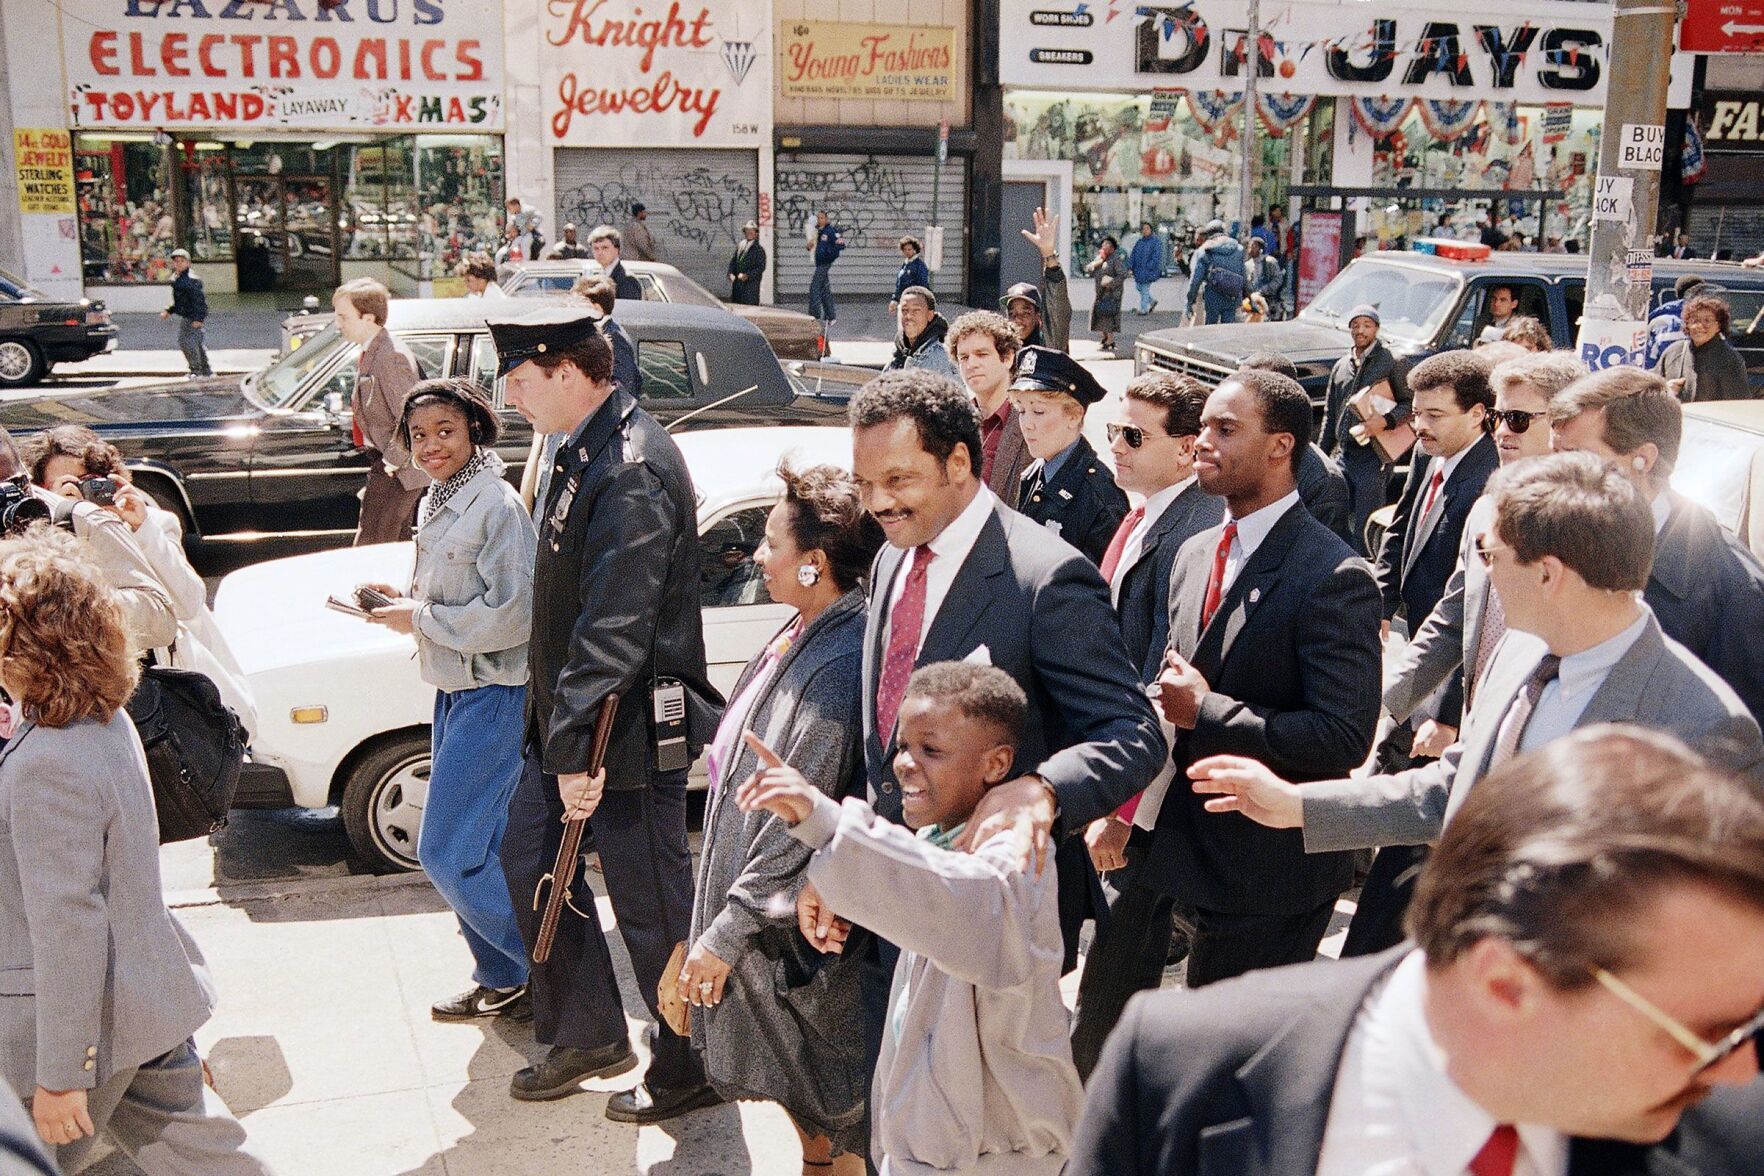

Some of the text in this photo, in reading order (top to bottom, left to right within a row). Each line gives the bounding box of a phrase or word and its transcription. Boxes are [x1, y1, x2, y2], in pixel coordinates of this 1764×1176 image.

[547, 0, 714, 73] Knight
[89, 31, 484, 81] ELECTRONICS
[788, 33, 950, 82] Young Fashions
[913, 76, 949, 86] WEAR
[85, 90, 264, 121] TOYLAND
[282, 99, 348, 116] LAYAWAY
[552, 70, 721, 138] Jewelry
[1705, 100, 1764, 140] FA
[1632, 127, 1664, 143] BUY
[1625, 147, 1662, 162] BLAC
[19, 169, 63, 181] STERLING
[24, 183, 68, 195] WATCHES
